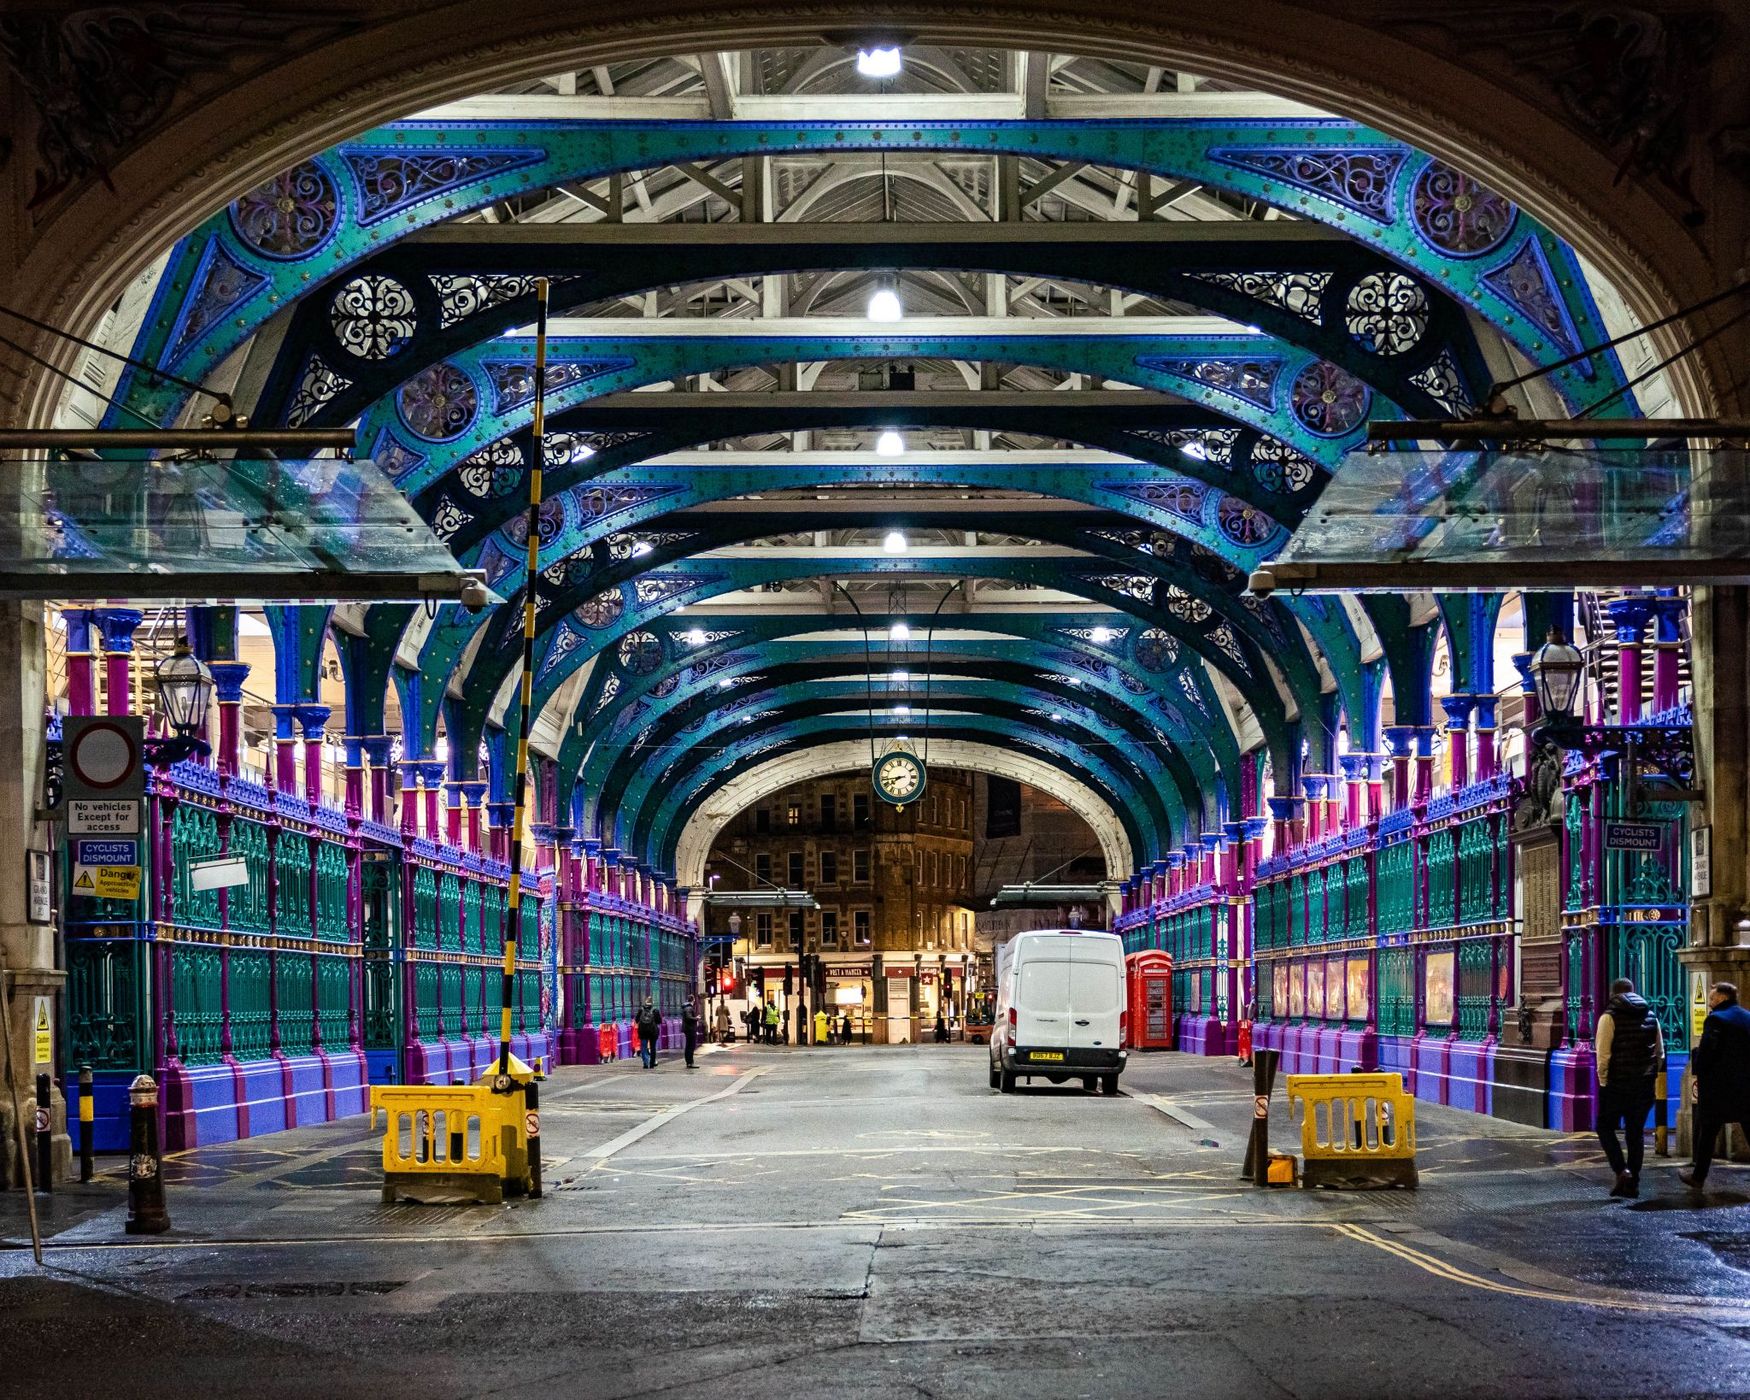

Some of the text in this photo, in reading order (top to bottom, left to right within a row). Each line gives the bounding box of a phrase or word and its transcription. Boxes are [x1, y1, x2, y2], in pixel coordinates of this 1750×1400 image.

[75, 803, 132, 811] No vehicles
[77, 813, 129, 822] Except for
[87, 823, 120, 831] access
[1612, 827, 1655, 837] CYCLISTS
[1609, 837, 1657, 847] DISMOUNT
[85, 844, 129, 852] CYCLISTS
[83, 854, 132, 863] DISMOUNT
